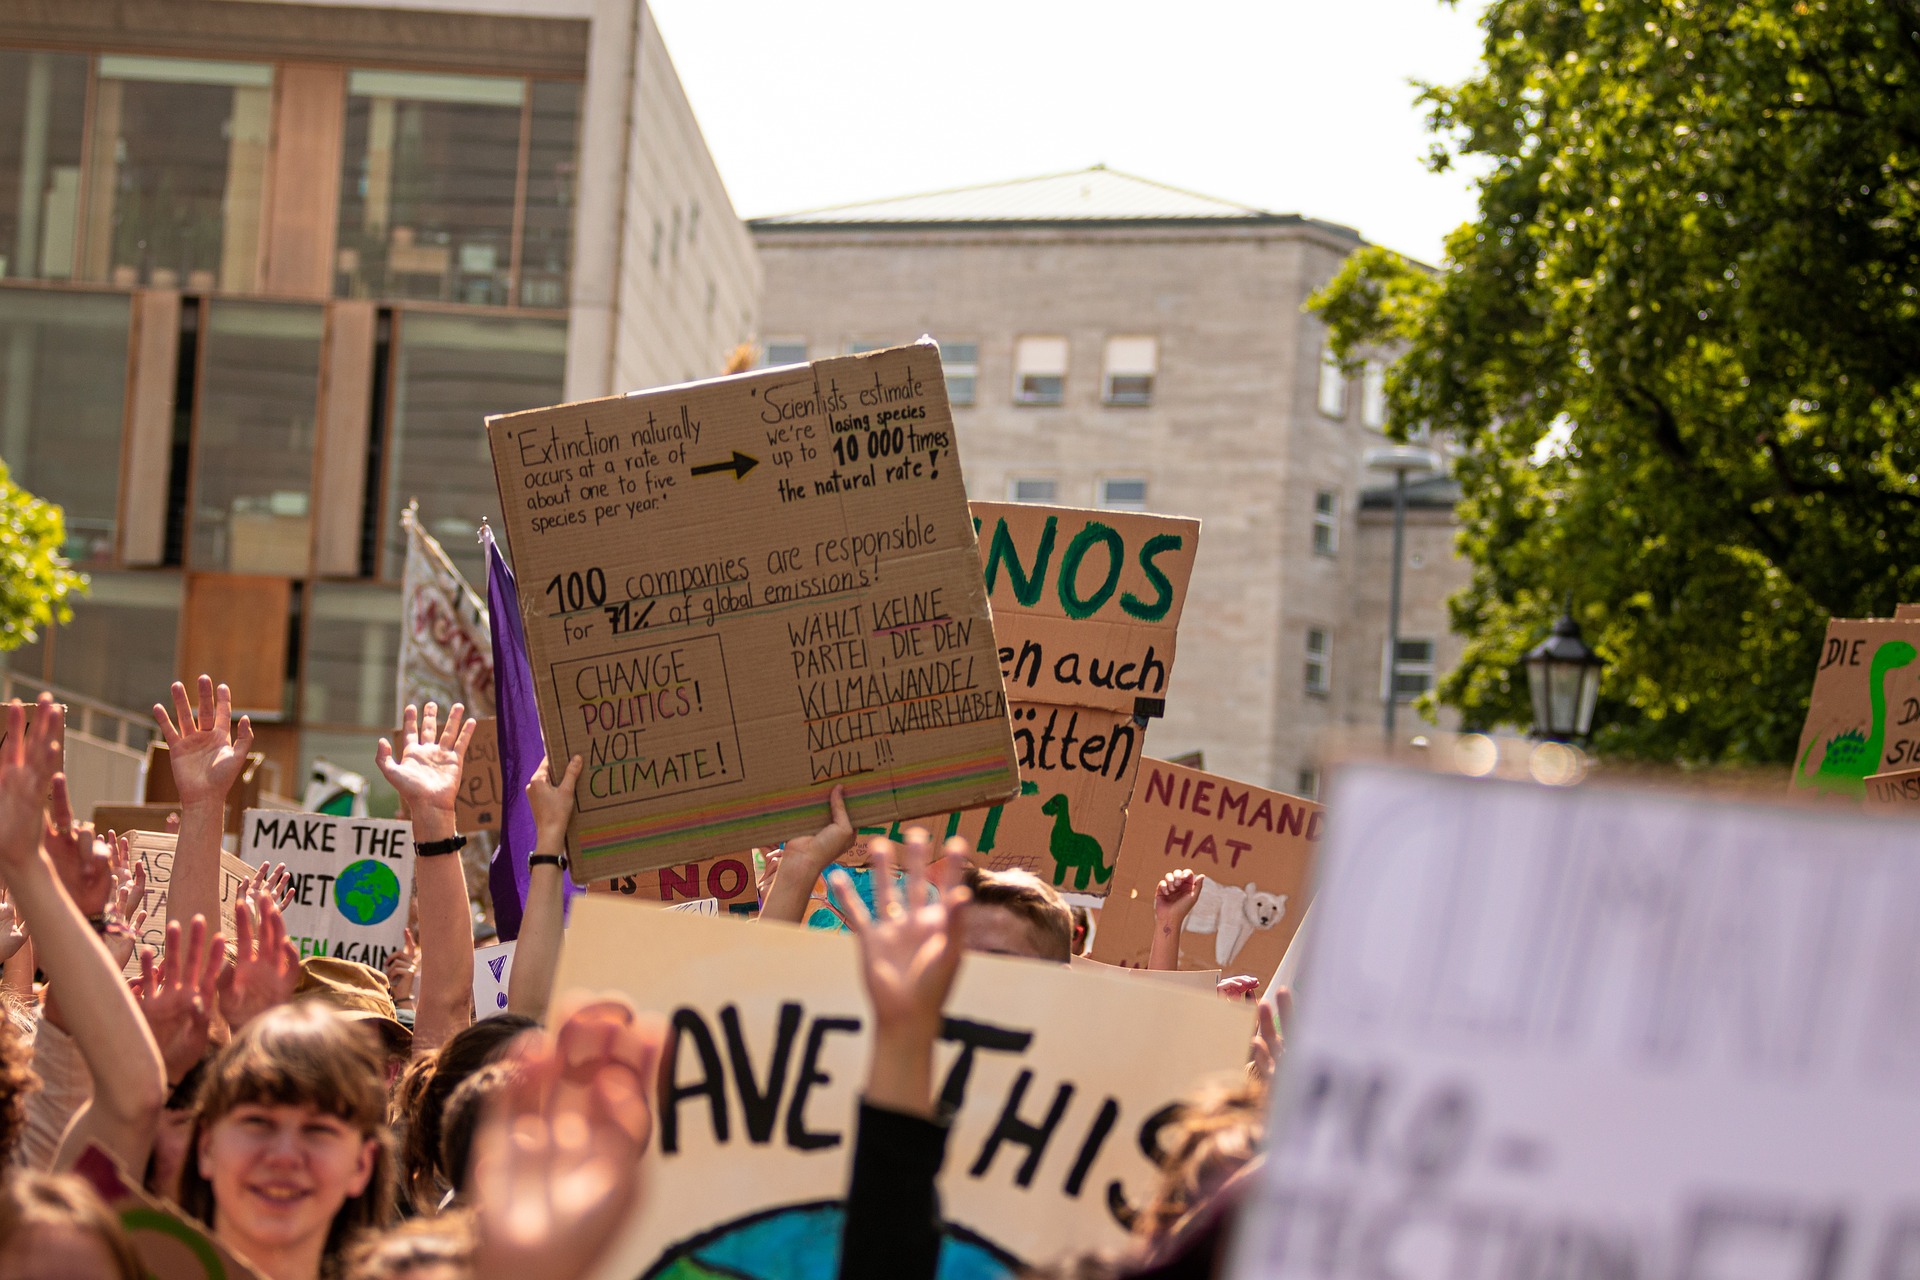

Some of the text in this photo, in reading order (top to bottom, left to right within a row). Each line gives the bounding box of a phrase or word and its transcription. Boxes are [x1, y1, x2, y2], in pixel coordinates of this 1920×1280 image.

[859, 366, 924, 407] estimate
[631, 405, 701, 444] naturally
[766, 404, 927, 447] we're losing species
[772, 423, 950, 470] up to 10 000 times
[524, 442, 687, 489] occurs at a rate of
[777, 478, 807, 503] the
[814, 463, 877, 496] natural
[527, 470, 677, 511] about one to five
[531, 510, 588, 535] species
[594, 504, 621, 527] per
[545, 514, 937, 614] 100 companies are responsible
[972, 514, 1183, 622] NOS
[563, 554, 880, 646] for 71% of global emissions!
[787, 587, 950, 649] WÄHLT KEINE
[890, 627, 924, 660] DIE
[932, 617, 973, 654] DEN
[1820, 638, 1867, 671] DIE
[575, 648, 692, 701] CHANGE
[797, 655, 979, 721] KLIMAWANDEL
[1053, 645, 1166, 694] auch
[579, 680, 704, 735] POLITICS!
[589, 728, 647, 767] NOT
[807, 709, 879, 751] NICHT
[590, 741, 727, 799] CLIMATE!
[252, 817, 407, 859] MAKE THE
[1163, 823, 1253, 869] HAT
[265, 872, 335, 908] NET
